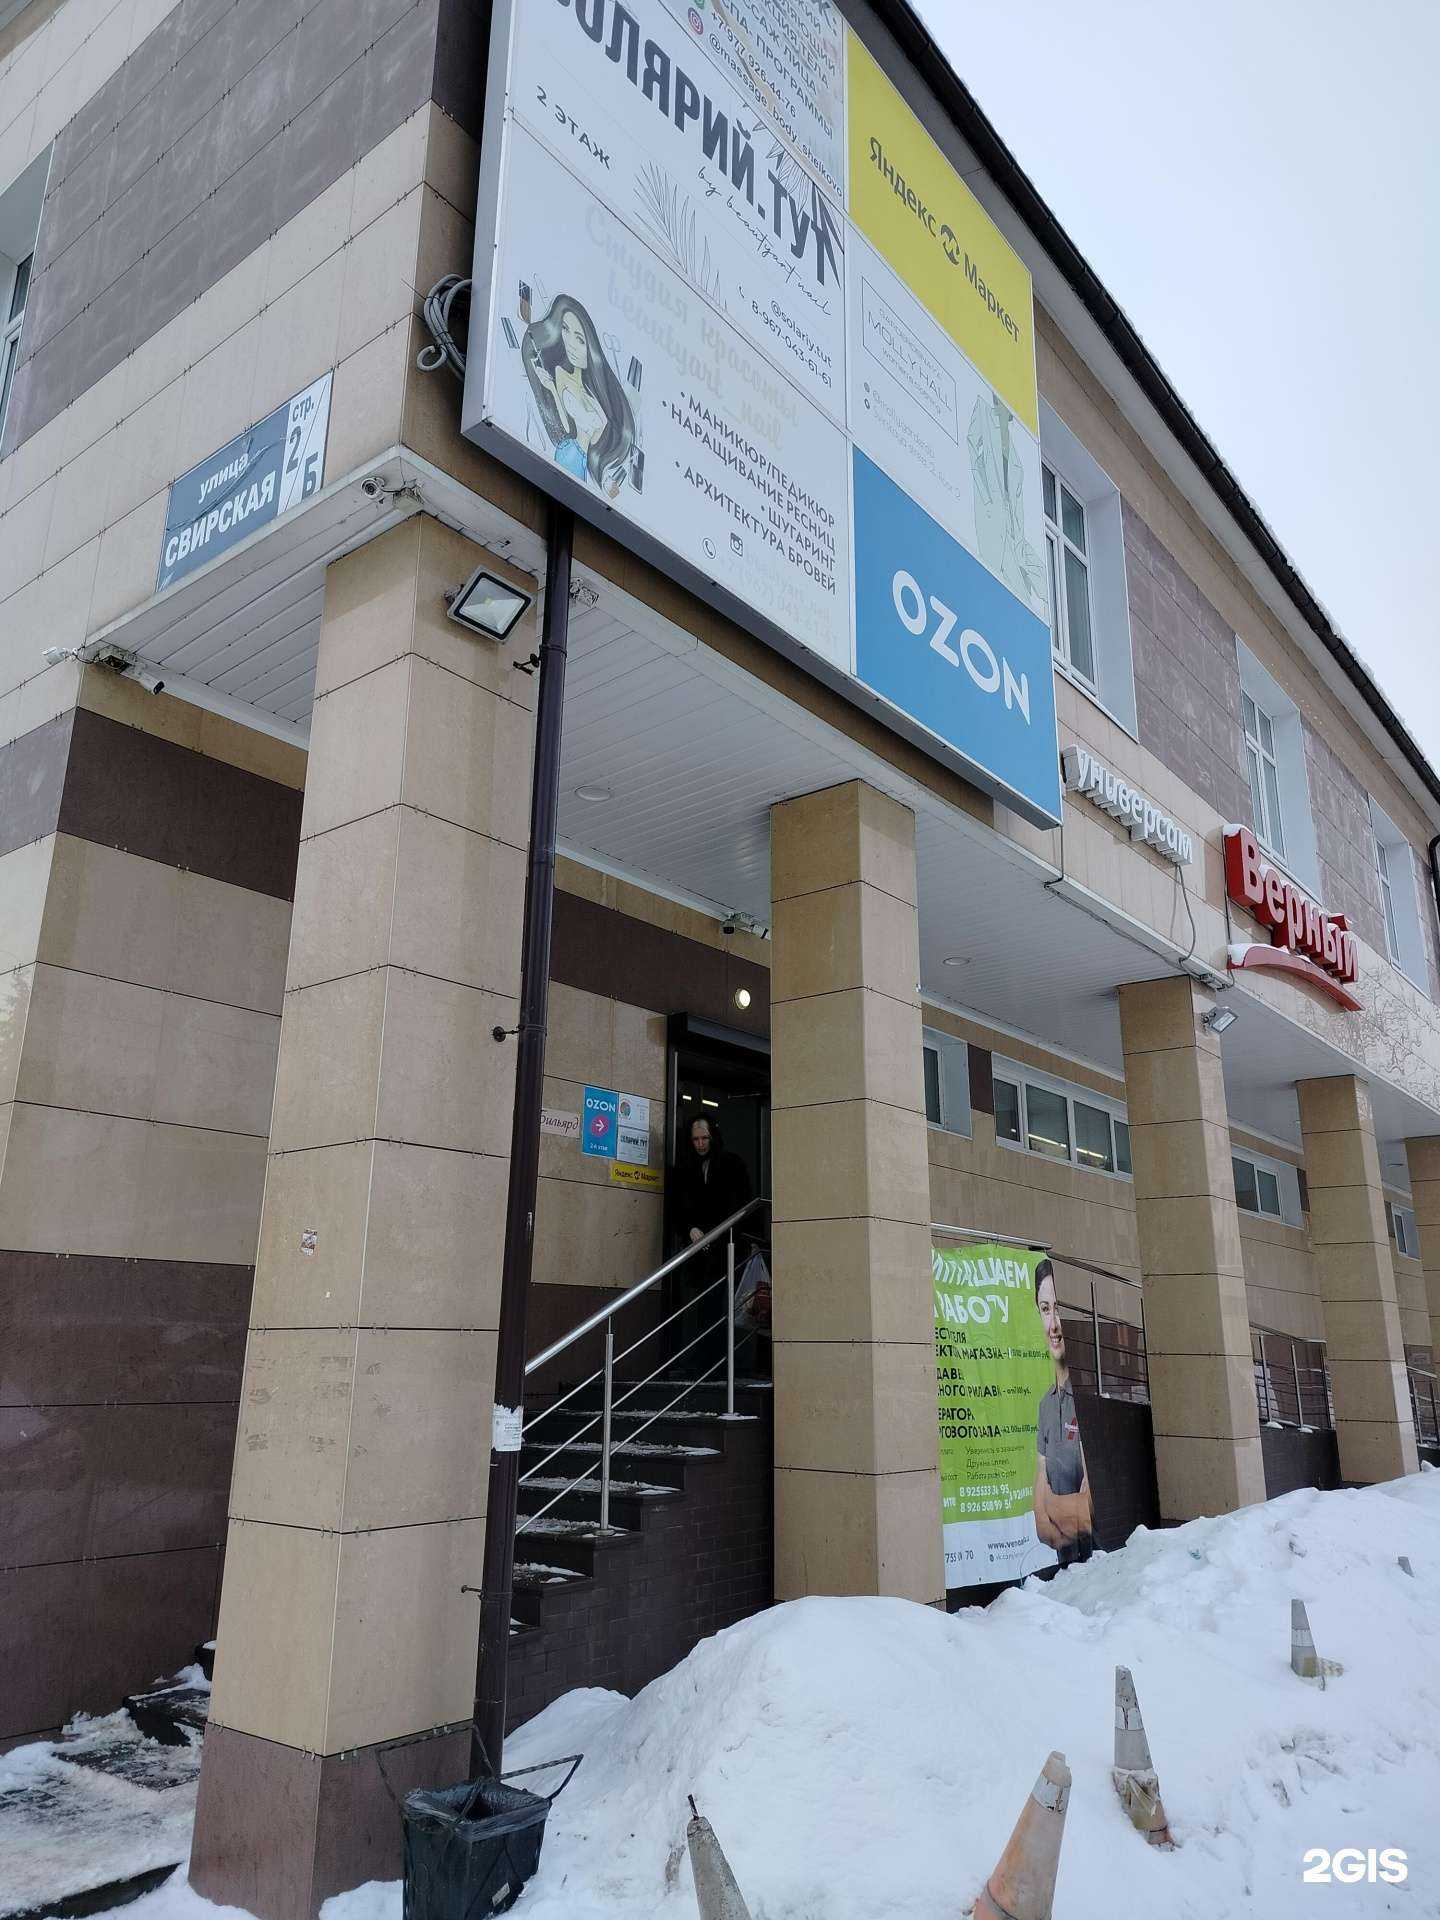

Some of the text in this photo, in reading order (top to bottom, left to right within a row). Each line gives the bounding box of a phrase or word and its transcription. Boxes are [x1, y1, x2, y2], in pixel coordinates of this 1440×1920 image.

[756, 33, 833, 139] ПРОГРАММЫ
[784, 45, 817, 95] ЛИЦА
[536, 85, 611, 170] 2 ЭТАЖ
[556, 0, 842, 289] ОЛЯРИЙ.ТУТ
[869, 136, 937, 238] Яндекс
[964, 251, 1020, 343] Маркет
[751, 300, 832, 388] 8-967-043-61-61
[770, 300, 832, 369] @solariy.tut
[867, 310, 917, 372] MOLLY
[292, 395, 315, 422] стр.
[198, 452, 249, 505] улица
[671, 403, 784, 509] НАРАЩИВАНИЕ
[786, 499, 836, 556] РЕСНИЦ
[689, 393, 835, 528] МАНИКЮР/ПЕДИКЮР
[164, 469, 276, 568] СВИРСКАЯ
[683, 465, 836, 596] АРХИТЕКТУРА БРОВЕЙ
[768, 506, 836, 572] ШУГАРИНГ
[892, 569, 1031, 727] OZON
[1226, 826, 1358, 984] Верный
[586, 1098, 616, 1113] OZON
